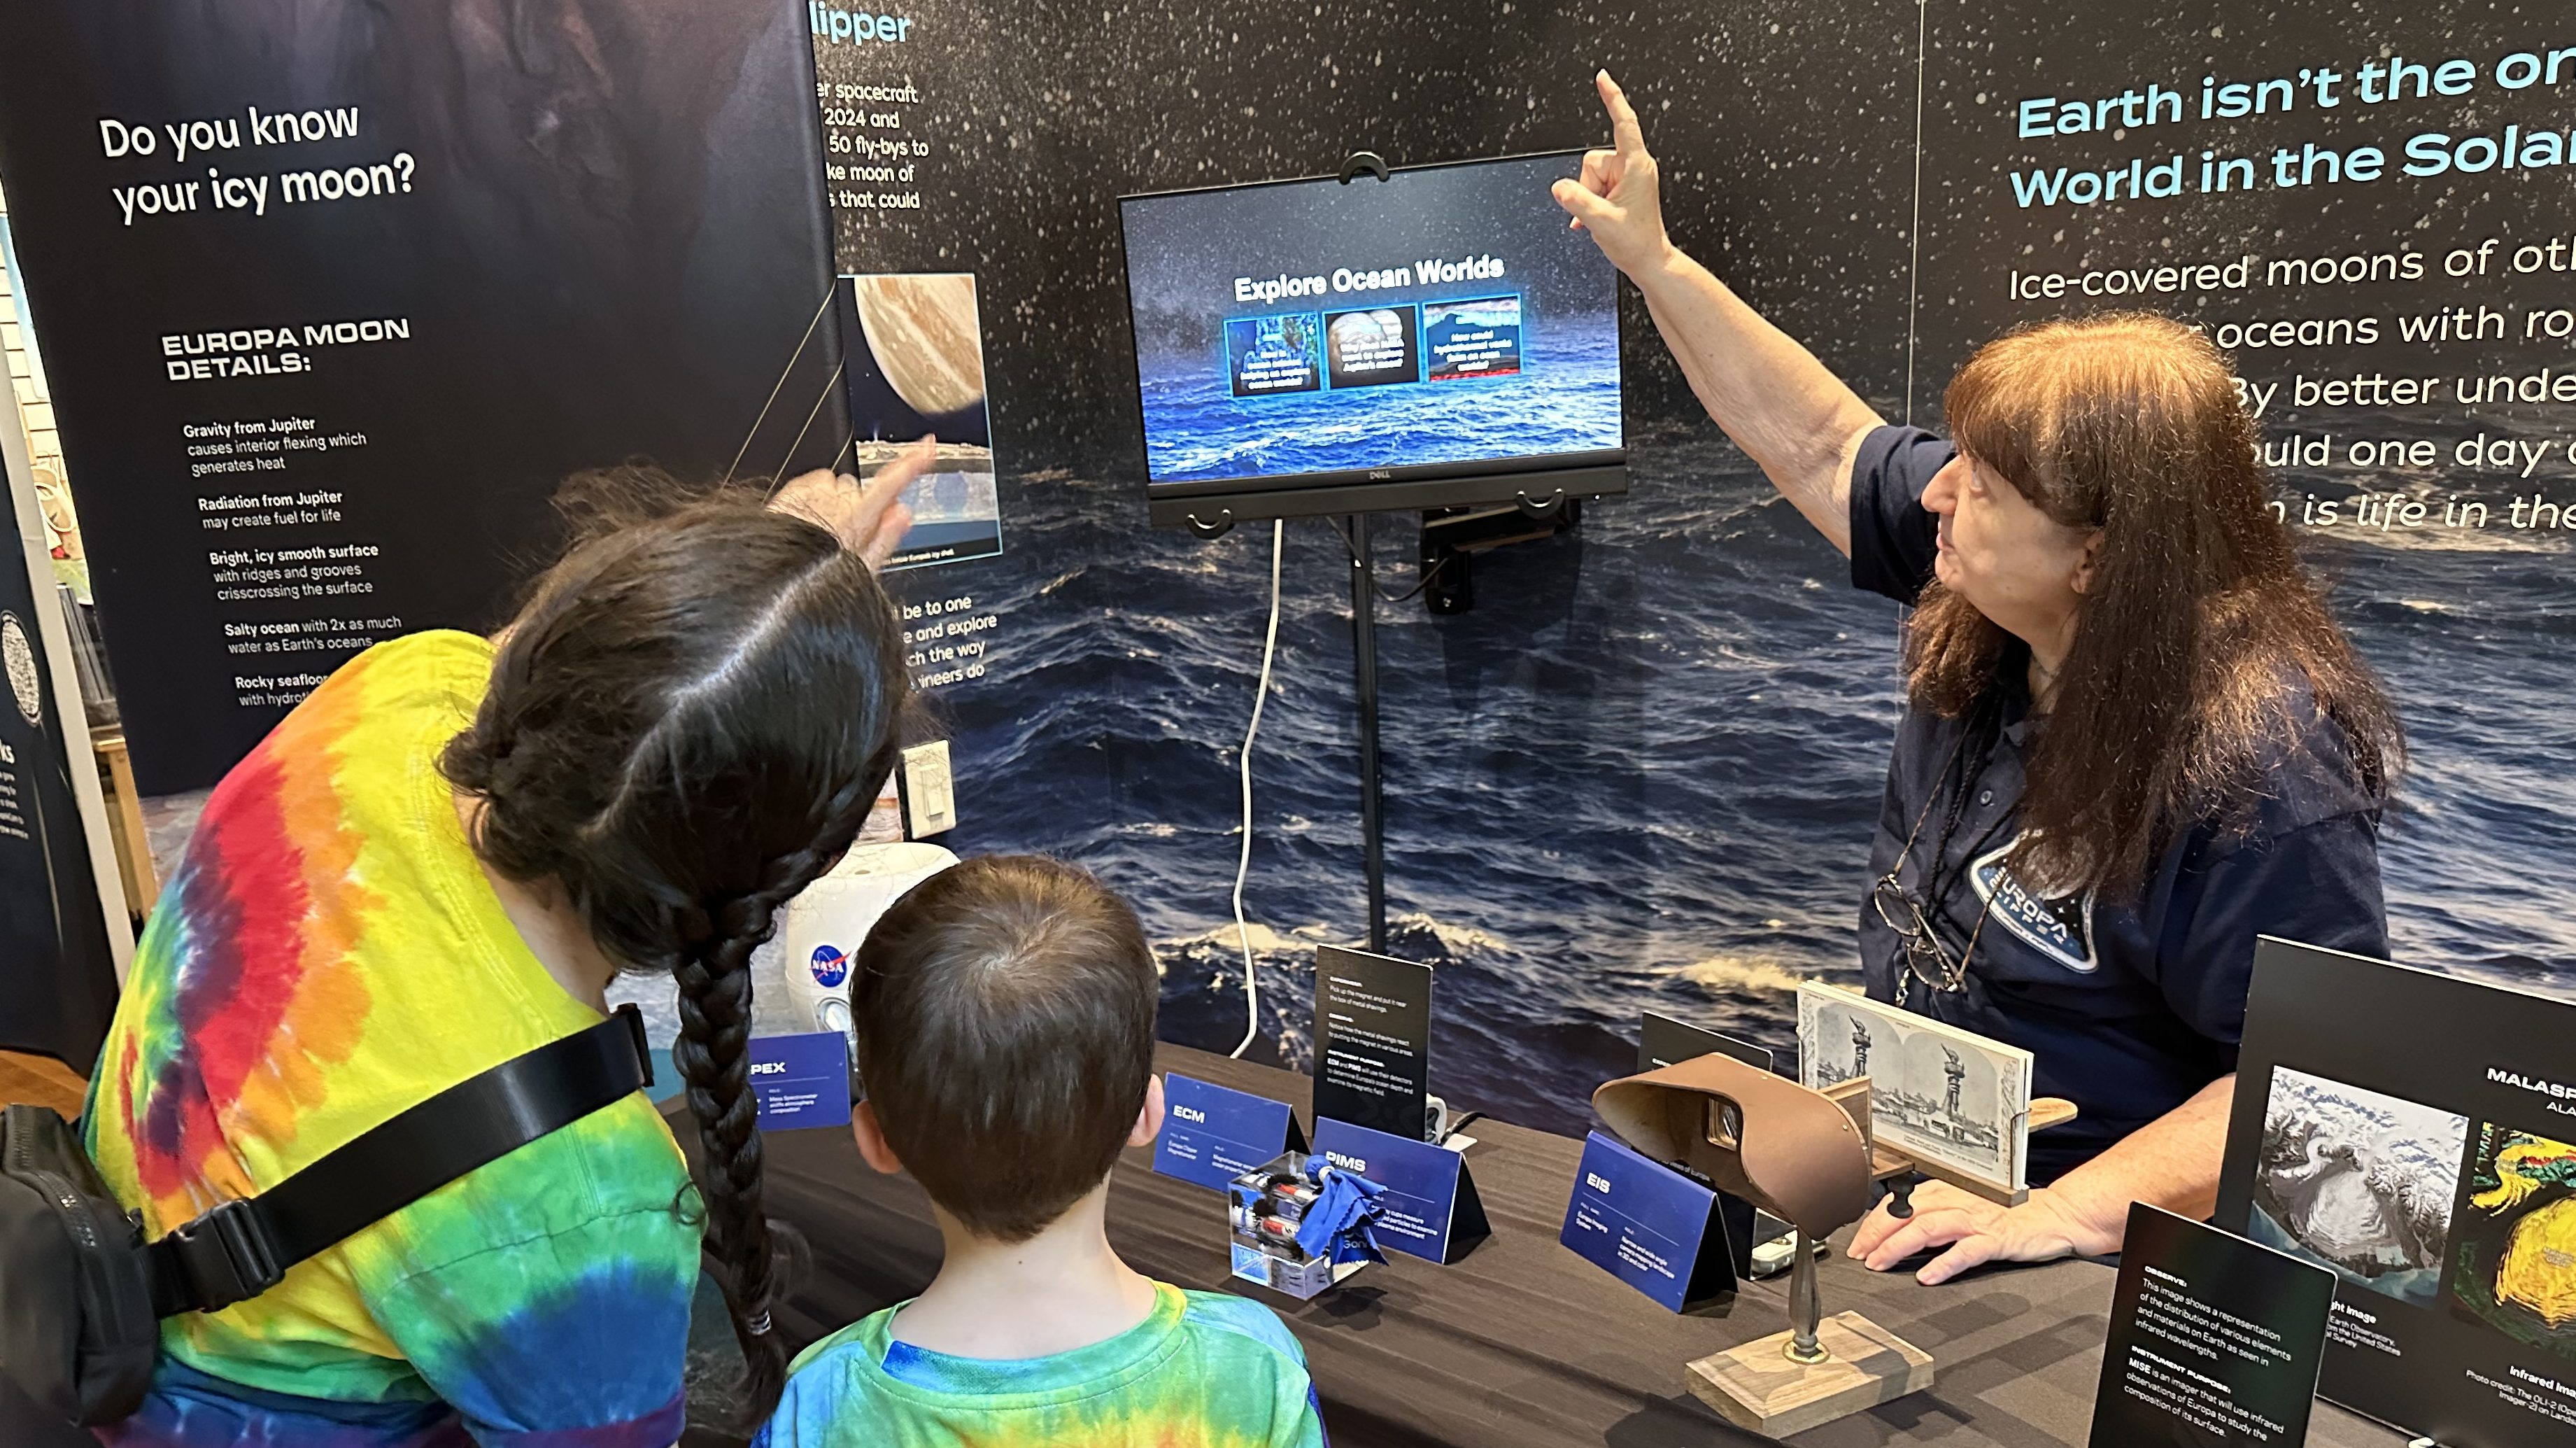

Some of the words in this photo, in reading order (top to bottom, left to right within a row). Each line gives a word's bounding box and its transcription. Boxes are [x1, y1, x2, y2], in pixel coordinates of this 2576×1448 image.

[809, 1, 910, 45] lipper
[835, 83, 919, 104] spacecraft
[2018, 83, 2182, 139] Earth
[2201, 68, 2342, 119] isn’t
[2357, 57, 2476, 104] the
[825, 108, 865, 126] 2024
[870, 112, 900, 128] and
[100, 119, 155, 157] Do
[165, 122, 241, 162] you
[248, 106, 359, 146] know
[829, 136, 851, 153] 50
[856, 135, 908, 160] fly-bys
[912, 140, 929, 156] to
[850, 165, 894, 182] moon
[898, 164, 915, 183] of
[2010, 155, 2183, 208] World
[2200, 151, 2254, 193] in
[2270, 143, 2385, 188] the
[113, 181, 199, 225] your
[208, 169, 268, 216] icy
[281, 153, 415, 203] moon?
[840, 190, 873, 208] that
[878, 192, 920, 209] could
[1234, 274, 1326, 304] Explore
[1332, 267, 1410, 292] Ocean
[1415, 253, 1505, 284] Worlds
[2010, 255, 2248, 300] Ice-covered
[2267, 248, 2423, 286] moons
[2444, 239, 2499, 276] of
[162, 327, 299, 355] EUROPA
[304, 318, 410, 346] MOON
[2216, 316, 2379, 349] oceans
[2399, 305, 2505, 342] with
[2526, 309, 2573, 338] ro
[167, 354, 311, 380] DETAILS:
[2294, 373, 2439, 407] better
[2456, 368, 2576, 404] unde
[183, 421, 231, 438] Gravity
[234, 420, 266, 434] from
[269, 416, 315, 434] Jupiter
[187, 440, 232, 456] causes
[235, 437, 280, 454] interior
[283, 434, 326, 451] flexing
[329, 432, 367, 447] which
[2349, 440, 2436, 467] one
[2455, 433, 2550, 479] day
[192, 459, 254, 477] generates
[256, 456, 285, 470] heat
[1369, 470, 1391, 480] DELL
[198, 495, 260, 511] Radiation
[262, 493, 293, 507] from
[297, 490, 342, 507] Jupiter
[2303, 493, 2338, 526] is
[2356, 493, 2427, 532] life
[2444, 494, 2487, 528] in
[203, 516, 228, 530] may
[232, 513, 271, 528] create
[274, 510, 298, 524] fuel
[300, 509, 318, 523] for
[321, 508, 341, 522] life
[209, 551, 253, 568] Bright,
[255, 549, 274, 564] icy
[278, 546, 326, 561] smooth
[329, 544, 378, 558] surface
[213, 570, 240, 582] with
[242, 568, 281, 583] ridges
[284, 565, 308, 578] and
[311, 564, 362, 580] grooves
[218, 584, 299, 600] crisscrossing
[302, 583, 323, 595] the
[326, 581, 373, 595] surface
[903, 605, 921, 619] be
[926, 601, 942, 615] to
[945, 596, 972, 612] one
[225, 623, 257, 638] Salty
[260, 623, 299, 635] ocean
[302, 619, 327, 633] with
[330, 618, 346, 631] 2x
[349, 619, 365, 630] as
[367, 616, 402, 629] much
[916, 624, 943, 641] and
[947, 615, 997, 636] explore
[228, 641, 262, 654] water
[264, 640, 280, 652] as
[327, 635, 373, 649] oceans
[929, 647, 954, 663] the
[958, 640, 986, 658] way
[966, 663, 984, 678] do
[235, 675, 274, 691] Rocky
[239, 693, 264, 706] with
[813, 959, 844, 973] NASA
[1173, 1104, 1205, 1123] ECM
[1326, 1151, 1366, 1172] PIMS
[1587, 1172, 1611, 1194] EIS
[2143, 1277, 2159, 1292] This
[2160, 1285, 2184, 1302] image
[2186, 1297, 2211, 1313] shows
[2218, 1312, 2281, 1342] representation
[2135, 1317, 2166, 1337] infrared
[2167, 1333, 2218, 1361] wavelengths.
[2137, 1306, 2153, 1318] and
[2153, 1313, 2191, 1334] materials
[2191, 1329, 2202, 1339] on
[2202, 1331, 2226, 1349] Earth
[2226, 1344, 2237, 1354] as
[2238, 1349, 2259, 1363] seen
[2260, 1356, 2269, 1367] in
[2149, 1296, 2163, 1308] the
[2163, 1302, 2209, 1327] distribution
[2210, 1322, 2220, 1331] of
[2220, 1326, 2251, 1344] various
[2251, 1339, 2291, 1361] elements
[2131, 1345, 2186, 1373] INSTRUMENT
[2466, 1370, 2489, 1384] Photo
[2517, 1388, 2532, 1400] The
[2510, 1365, 2554, 1389] Infrared
[2127, 1372, 2176, 1400] observations
[2187, 1398, 2216, 1417] Europa
[2218, 1412, 2226, 1422] to
[2228, 1418, 2251, 1435] study
[2253, 1428, 2267, 1441] the
[2129, 1357, 2151, 1375] MISE
[2151, 1368, 2159, 1378] is
[2160, 1373, 2170, 1383] an
[2171, 1377, 2199, 1395] imager
[2200, 1390, 2217, 1404] that
[2218, 1399, 2232, 1410] will
[2233, 1406, 2249, 1418] use
[2250, 1412, 2284, 1433] infrared
[2124, 1386, 2171, 1411] composition
[2193, 1417, 2226, 1437] surface.
